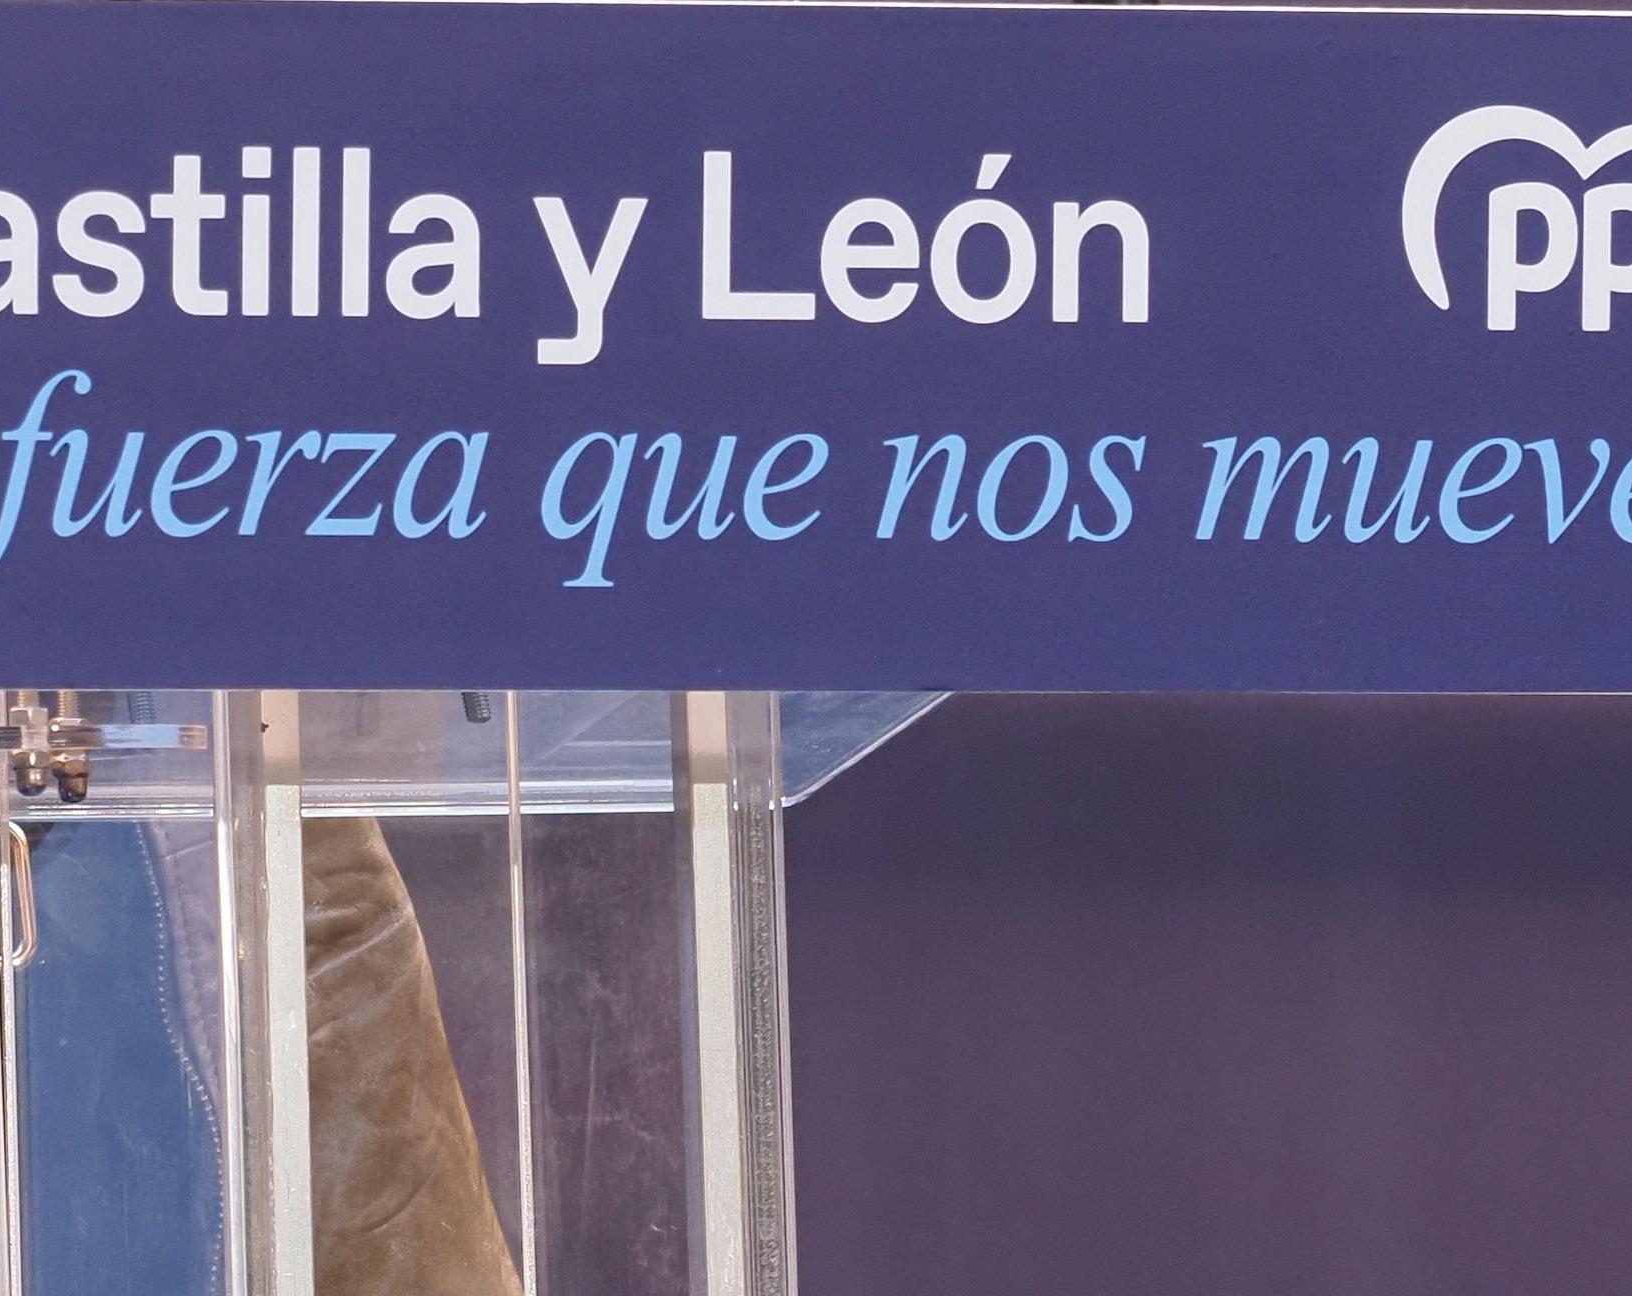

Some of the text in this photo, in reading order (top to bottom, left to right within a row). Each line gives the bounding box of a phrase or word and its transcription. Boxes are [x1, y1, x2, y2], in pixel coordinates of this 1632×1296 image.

[532, 196, 649, 365] y
[701, 150, 1150, 325] León
[540, 430, 829, 588] que
[875, 433, 1147, 542] nos
